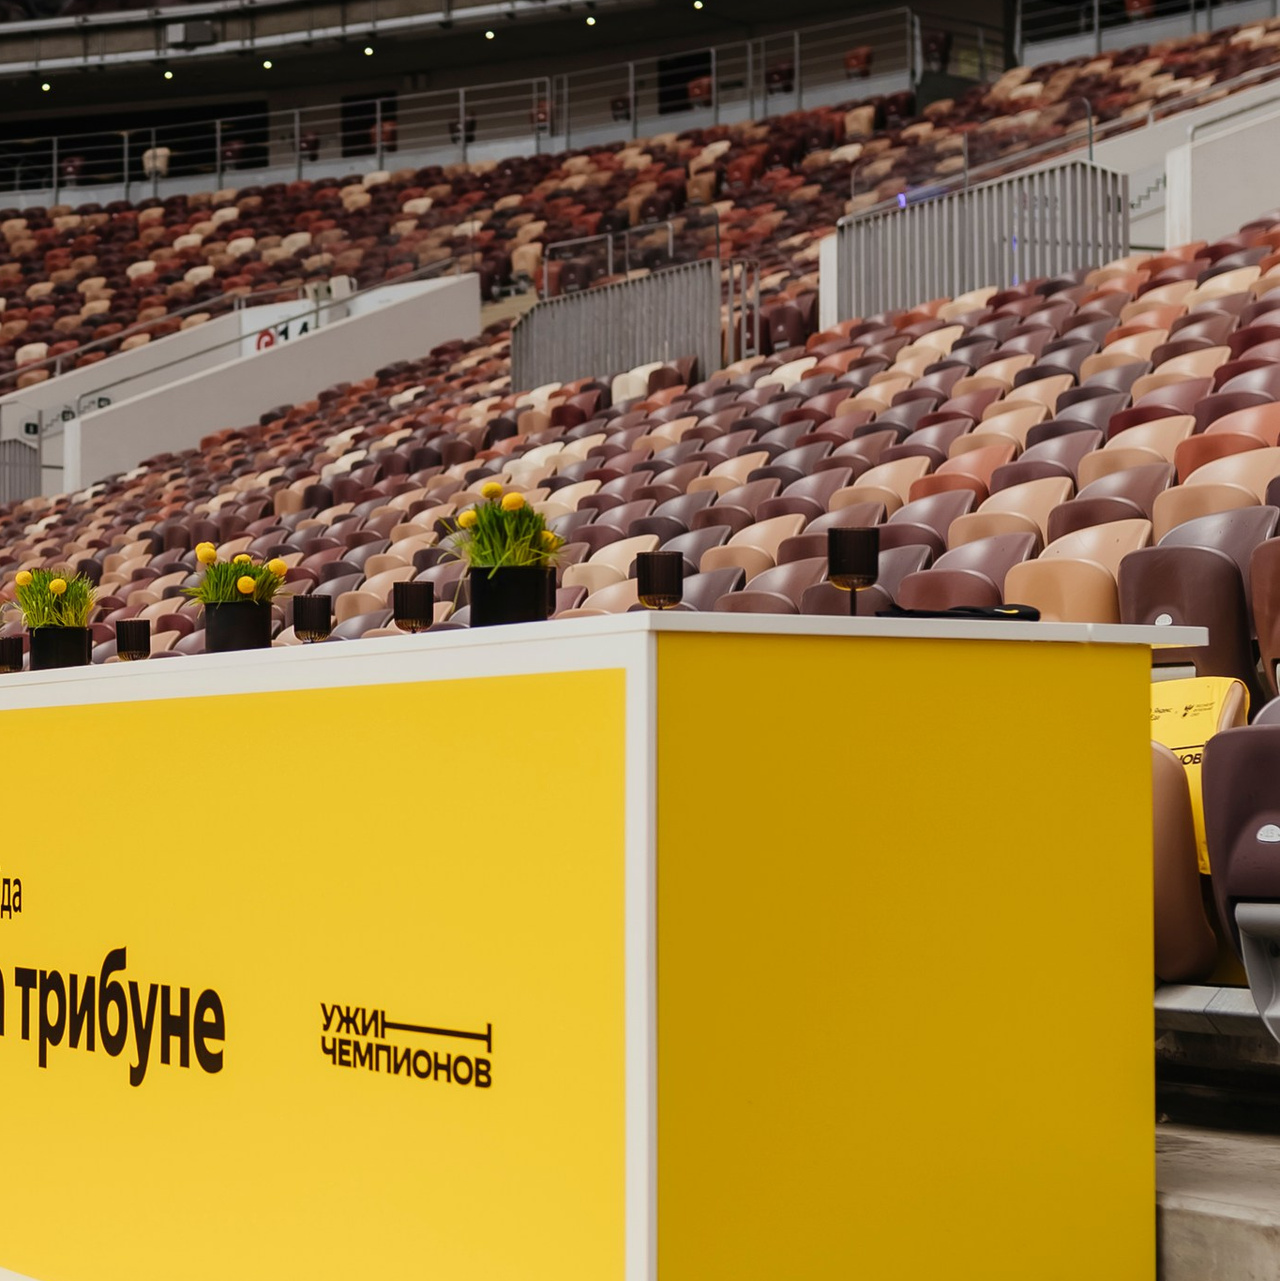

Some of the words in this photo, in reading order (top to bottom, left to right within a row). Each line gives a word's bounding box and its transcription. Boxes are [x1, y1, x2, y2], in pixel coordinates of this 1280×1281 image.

[14, 945, 227, 1088] трибуне
[320, 1002, 493, 1054] УЖИН
[321, 1035, 493, 1089] ЧЕМПИОНОВ
